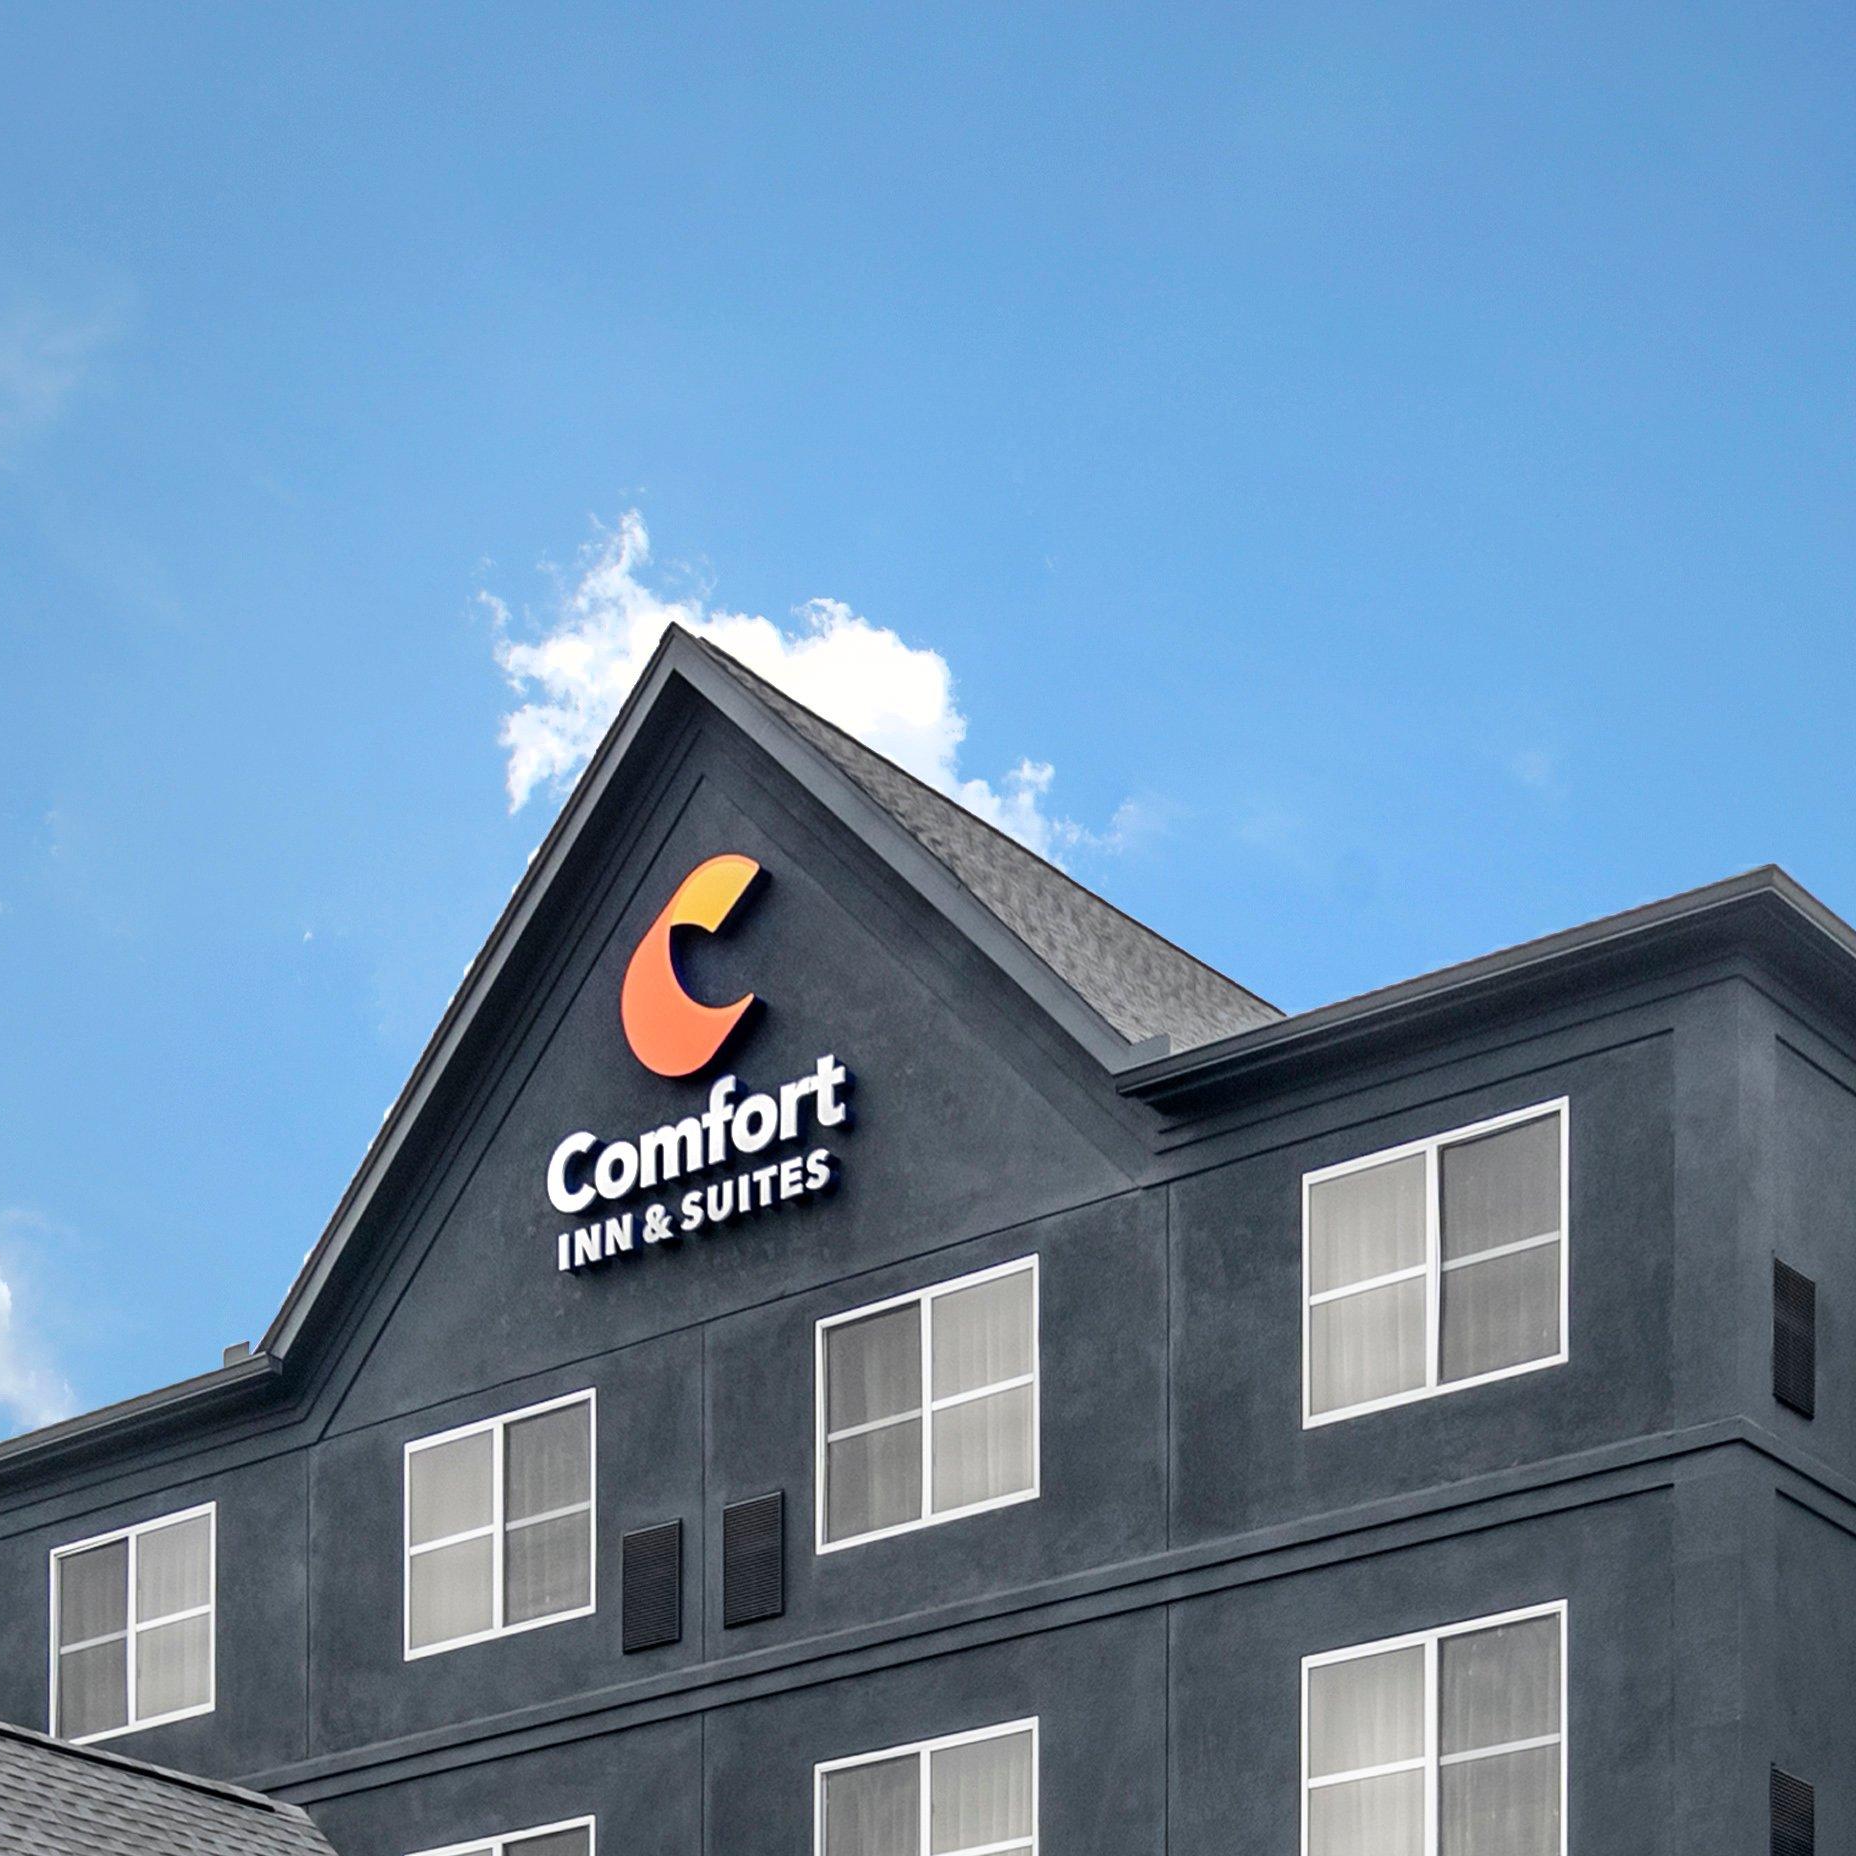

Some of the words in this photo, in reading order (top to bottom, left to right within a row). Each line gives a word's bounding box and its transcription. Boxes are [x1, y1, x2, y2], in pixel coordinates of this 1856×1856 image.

[546, 1054, 845, 1213] Comfort
[557, 1212, 634, 1271] INN
[642, 1203, 674, 1244] &
[680, 1148, 831, 1232] SUITES
